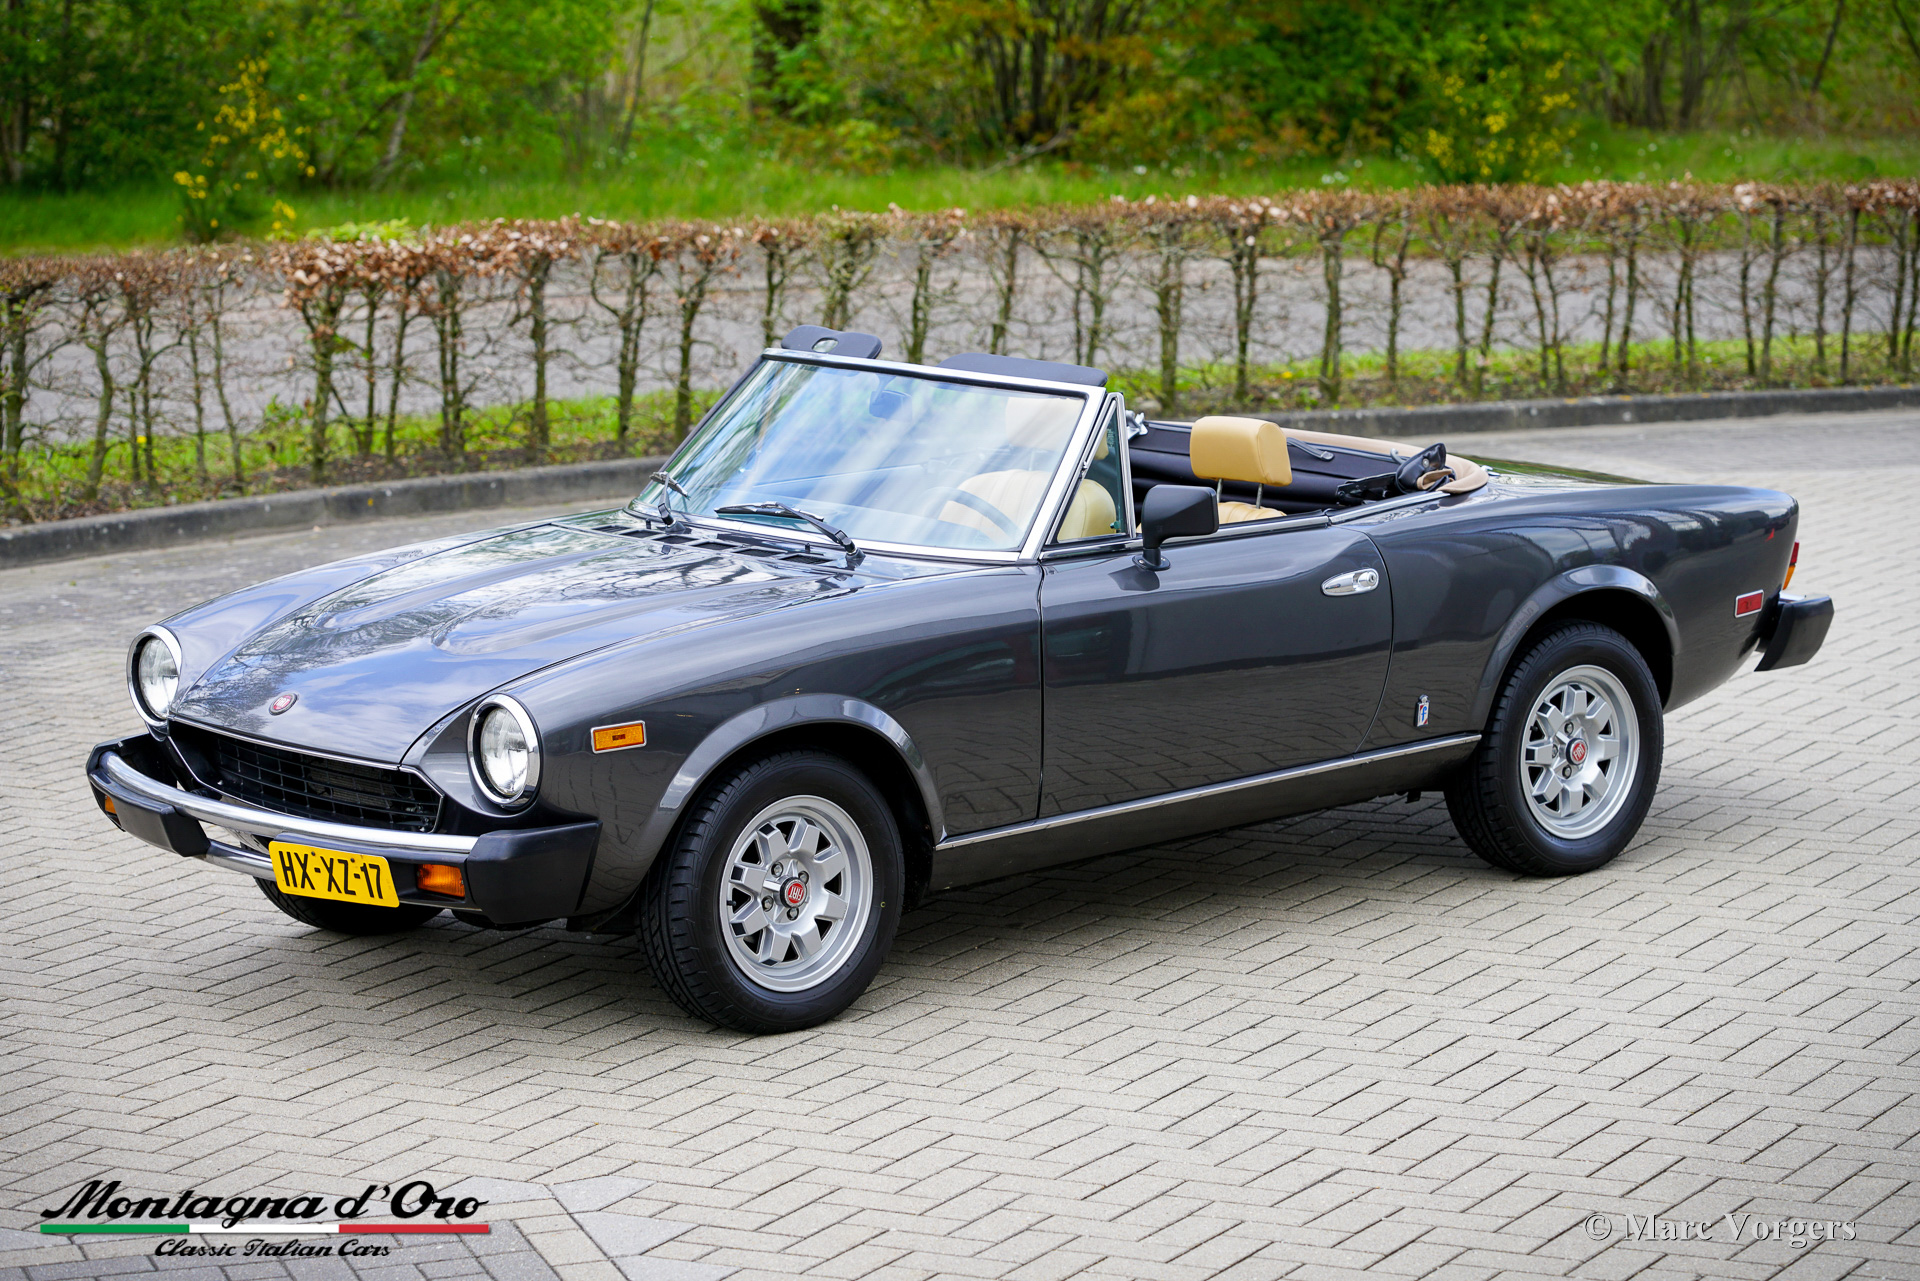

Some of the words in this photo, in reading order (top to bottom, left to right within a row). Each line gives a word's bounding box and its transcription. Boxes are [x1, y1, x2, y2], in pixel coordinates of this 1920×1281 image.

[1573, 743, 1585, 761] FIAT
[278, 851, 383, 899] HX-XZ-17
[789, 886, 803, 900] FIAT
